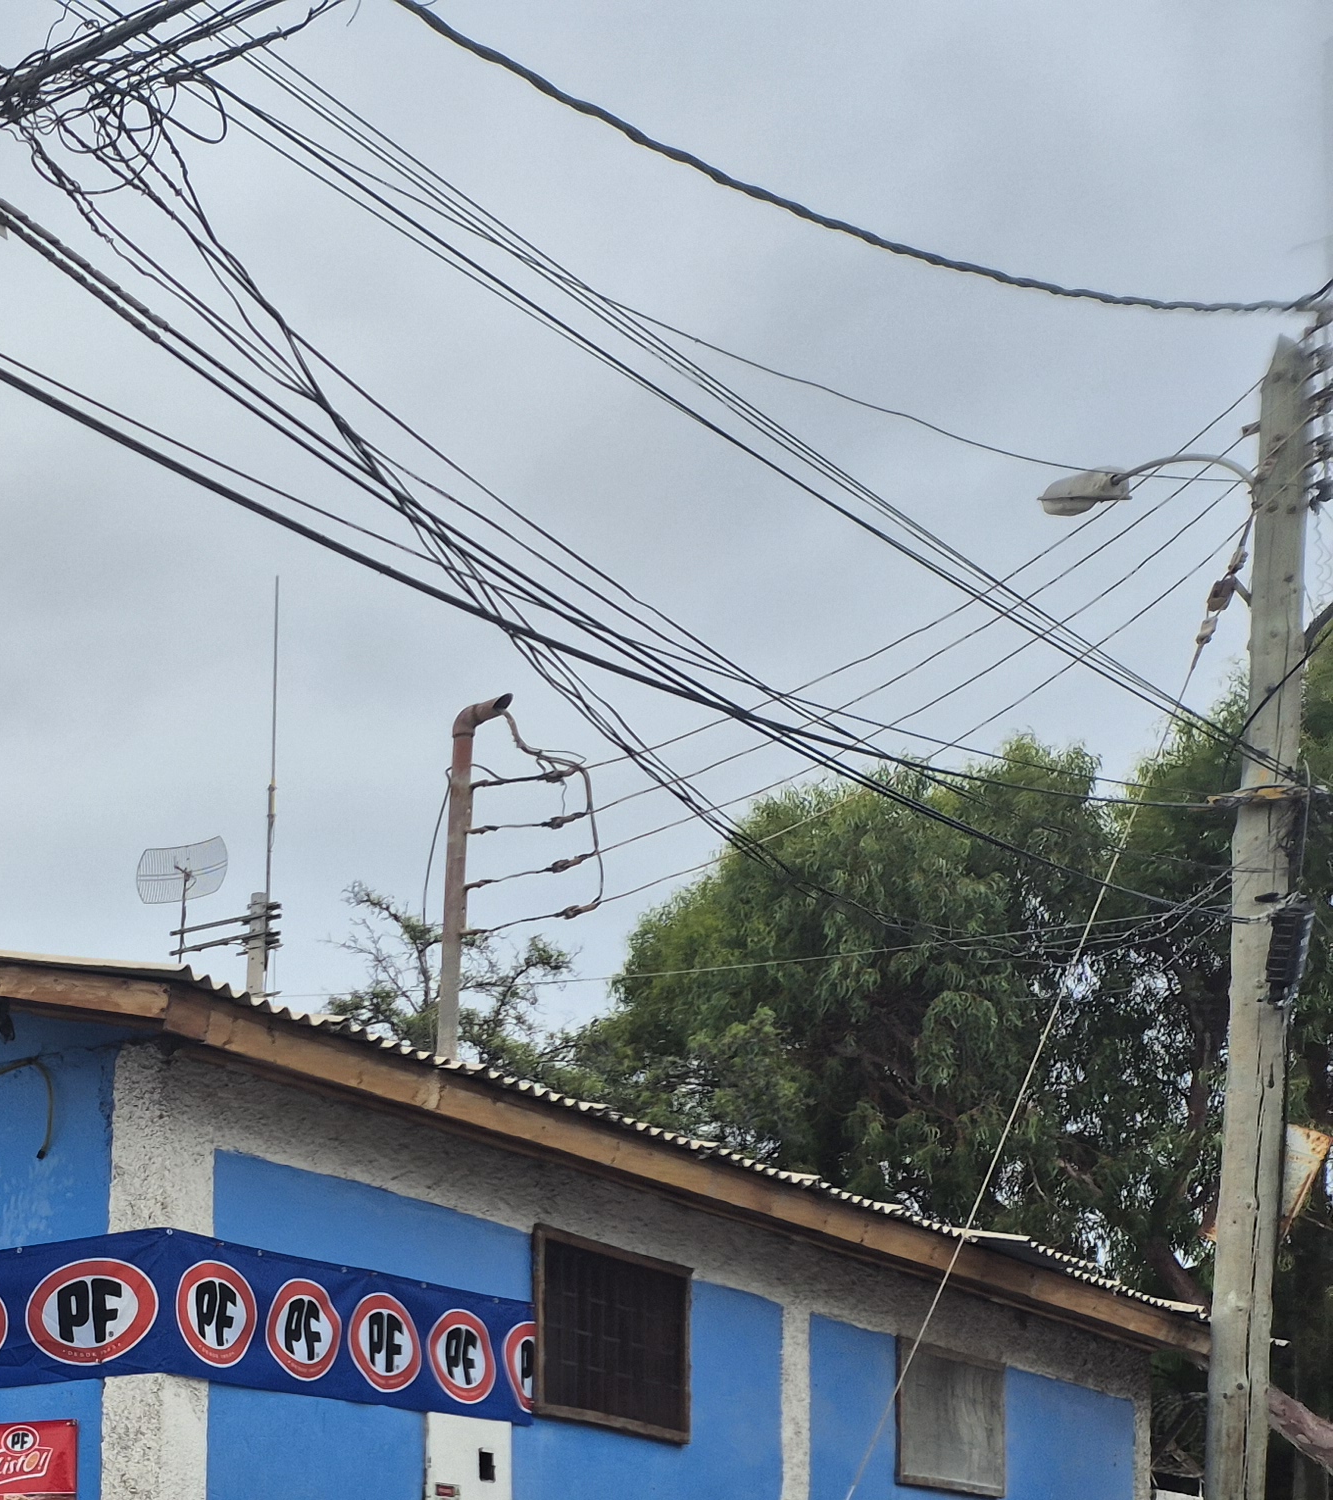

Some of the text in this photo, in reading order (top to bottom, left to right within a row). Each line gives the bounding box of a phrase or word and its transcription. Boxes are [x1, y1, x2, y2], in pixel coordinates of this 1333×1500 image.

[57, 1278, 122, 1343] PF
[196, 1280, 237, 1346] PF
[285, 1298, 322, 1361] PF
[368, 1312, 404, 1373] PF
[445, 1327, 478, 1385] PF
[11, 1432, 30, 1450] PF
